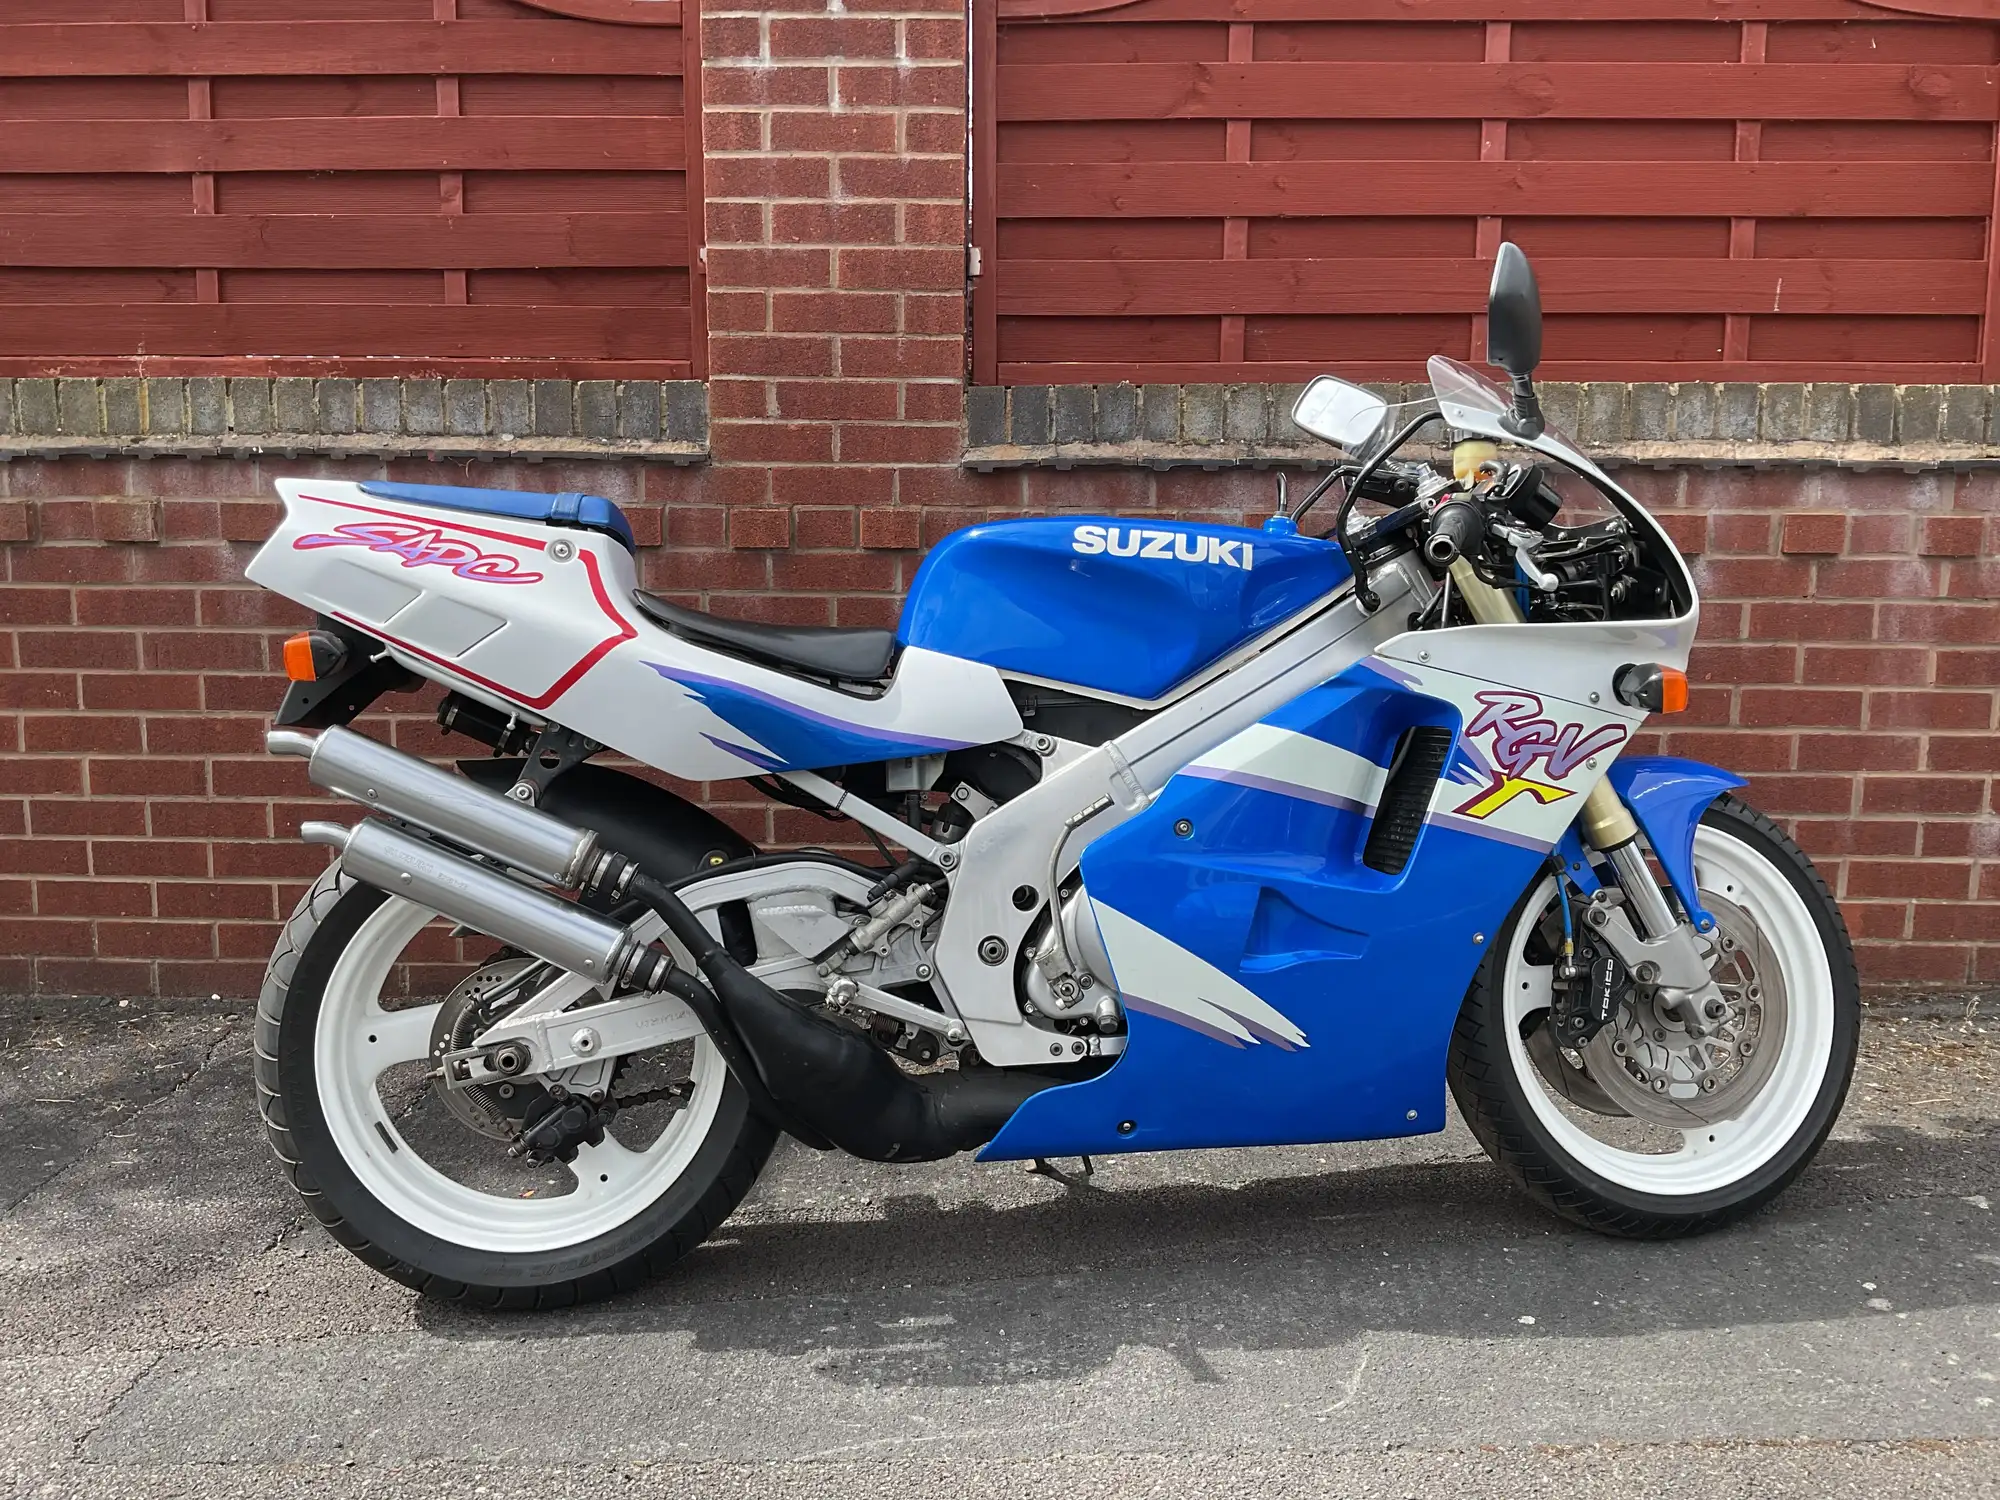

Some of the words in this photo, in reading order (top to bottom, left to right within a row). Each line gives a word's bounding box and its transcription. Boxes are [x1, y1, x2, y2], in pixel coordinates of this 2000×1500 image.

[1072, 525, 1253, 571] SUZUKI
[1465, 690, 1628, 781] RGV
[1601, 959, 1614, 1021] TOKICO
